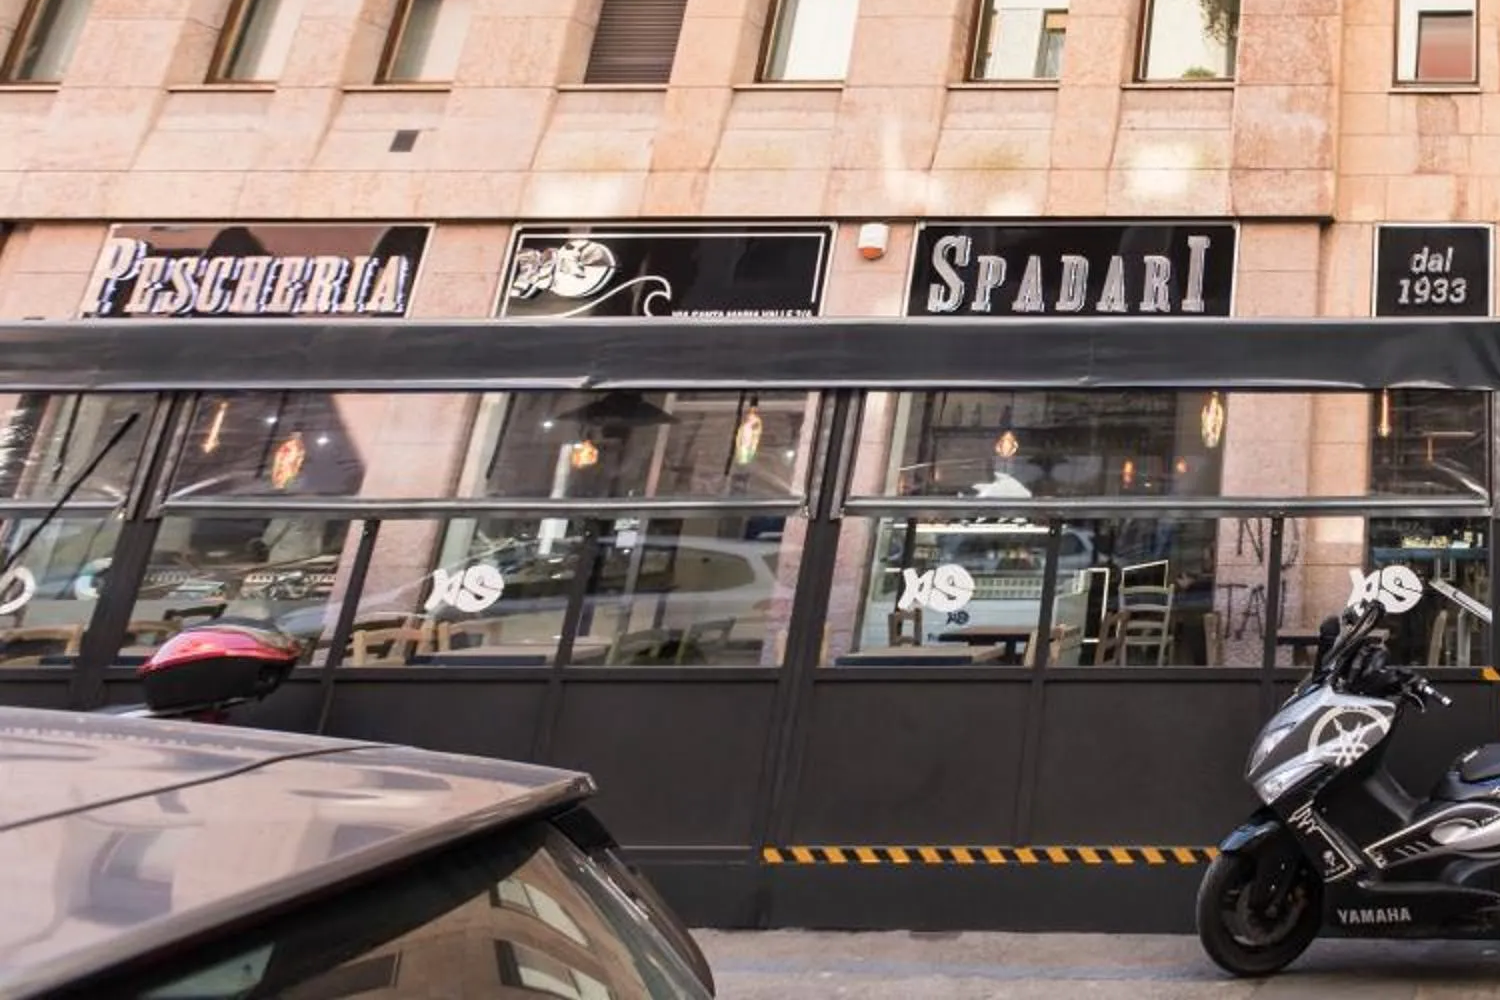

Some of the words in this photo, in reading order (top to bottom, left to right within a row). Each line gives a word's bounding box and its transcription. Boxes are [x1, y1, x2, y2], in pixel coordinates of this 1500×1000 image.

[927, 235, 1211, 312] SPADARI
[1411, 246, 1454, 273] dal
[81, 238, 408, 315] PESCHERIA
[1398, 276, 1467, 304] 1933
[1337, 907, 1412, 924] YAMAHA
